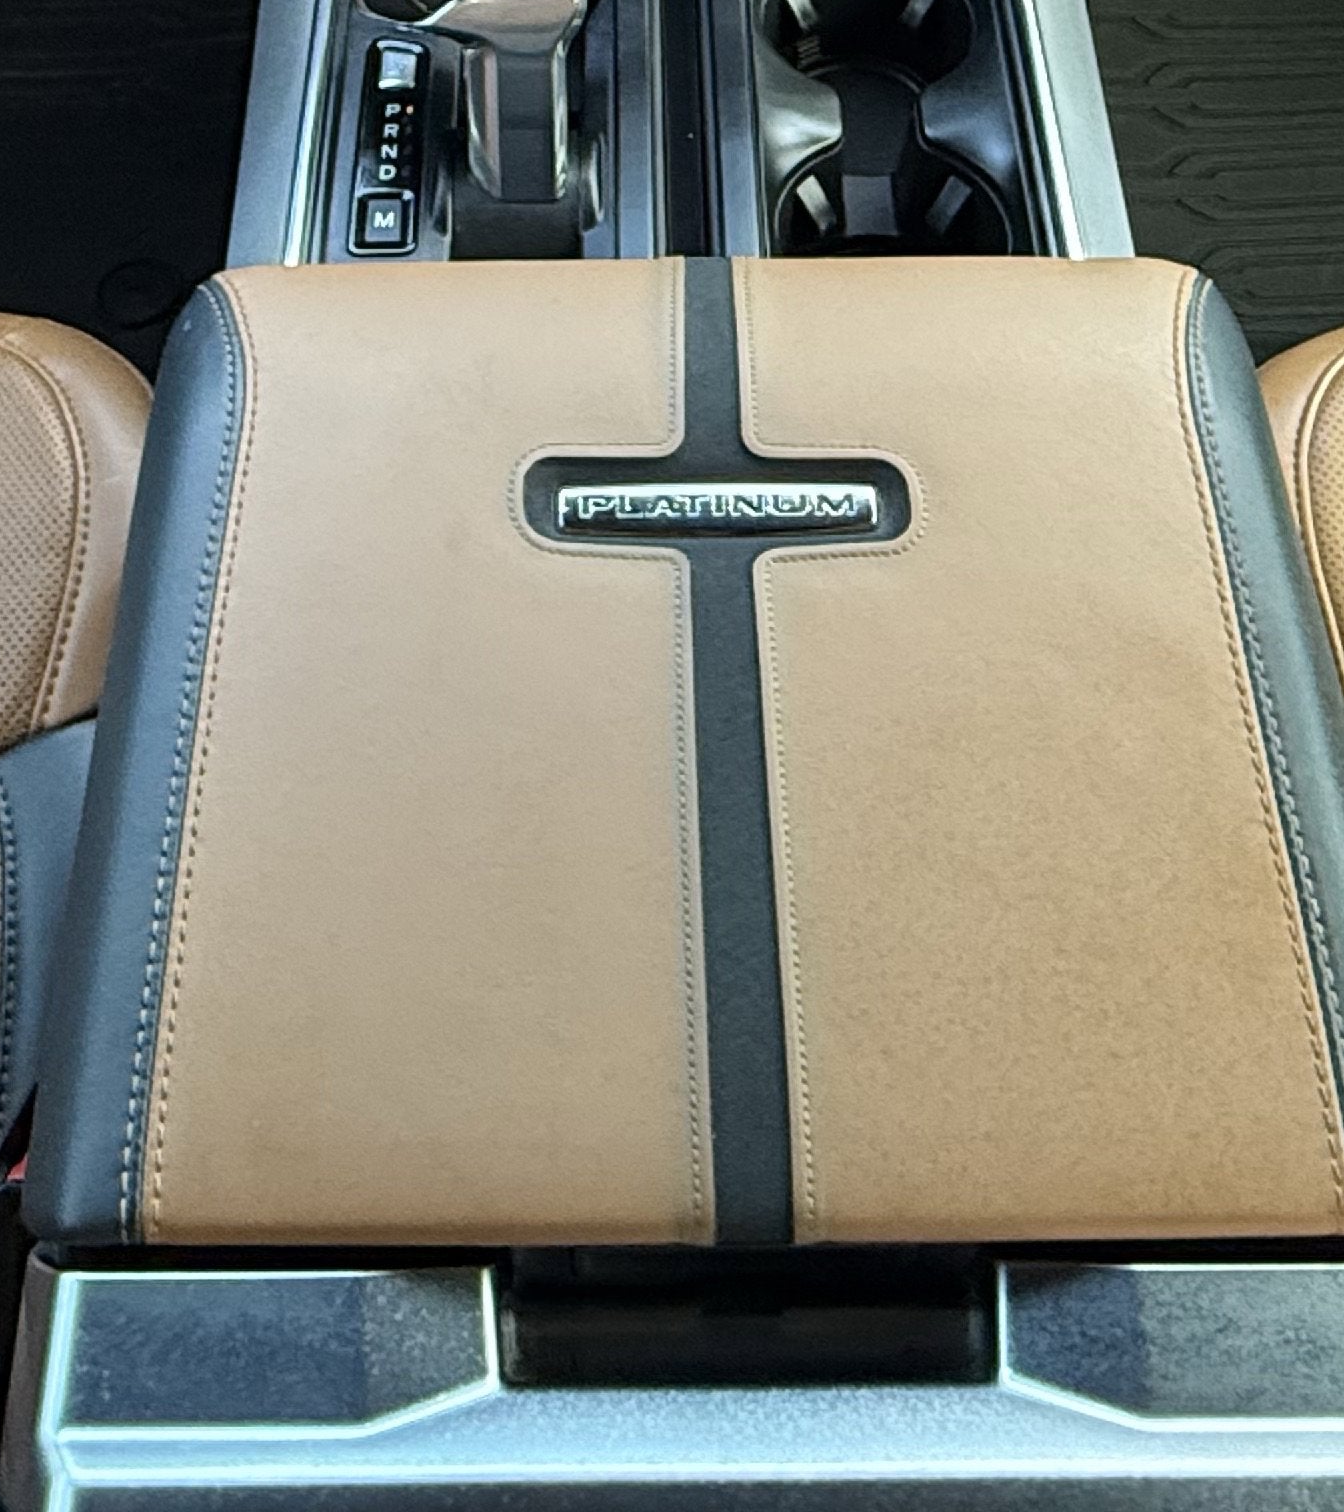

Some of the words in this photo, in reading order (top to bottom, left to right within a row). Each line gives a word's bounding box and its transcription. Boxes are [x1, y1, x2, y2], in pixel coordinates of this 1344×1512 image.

[384, 102, 403, 119] P
[382, 123, 401, 139] R
[380, 143, 399, 161] N
[378, 163, 398, 182] D
[373, 211, 395, 229] M
[577, 492, 858, 521] PLATINUM
